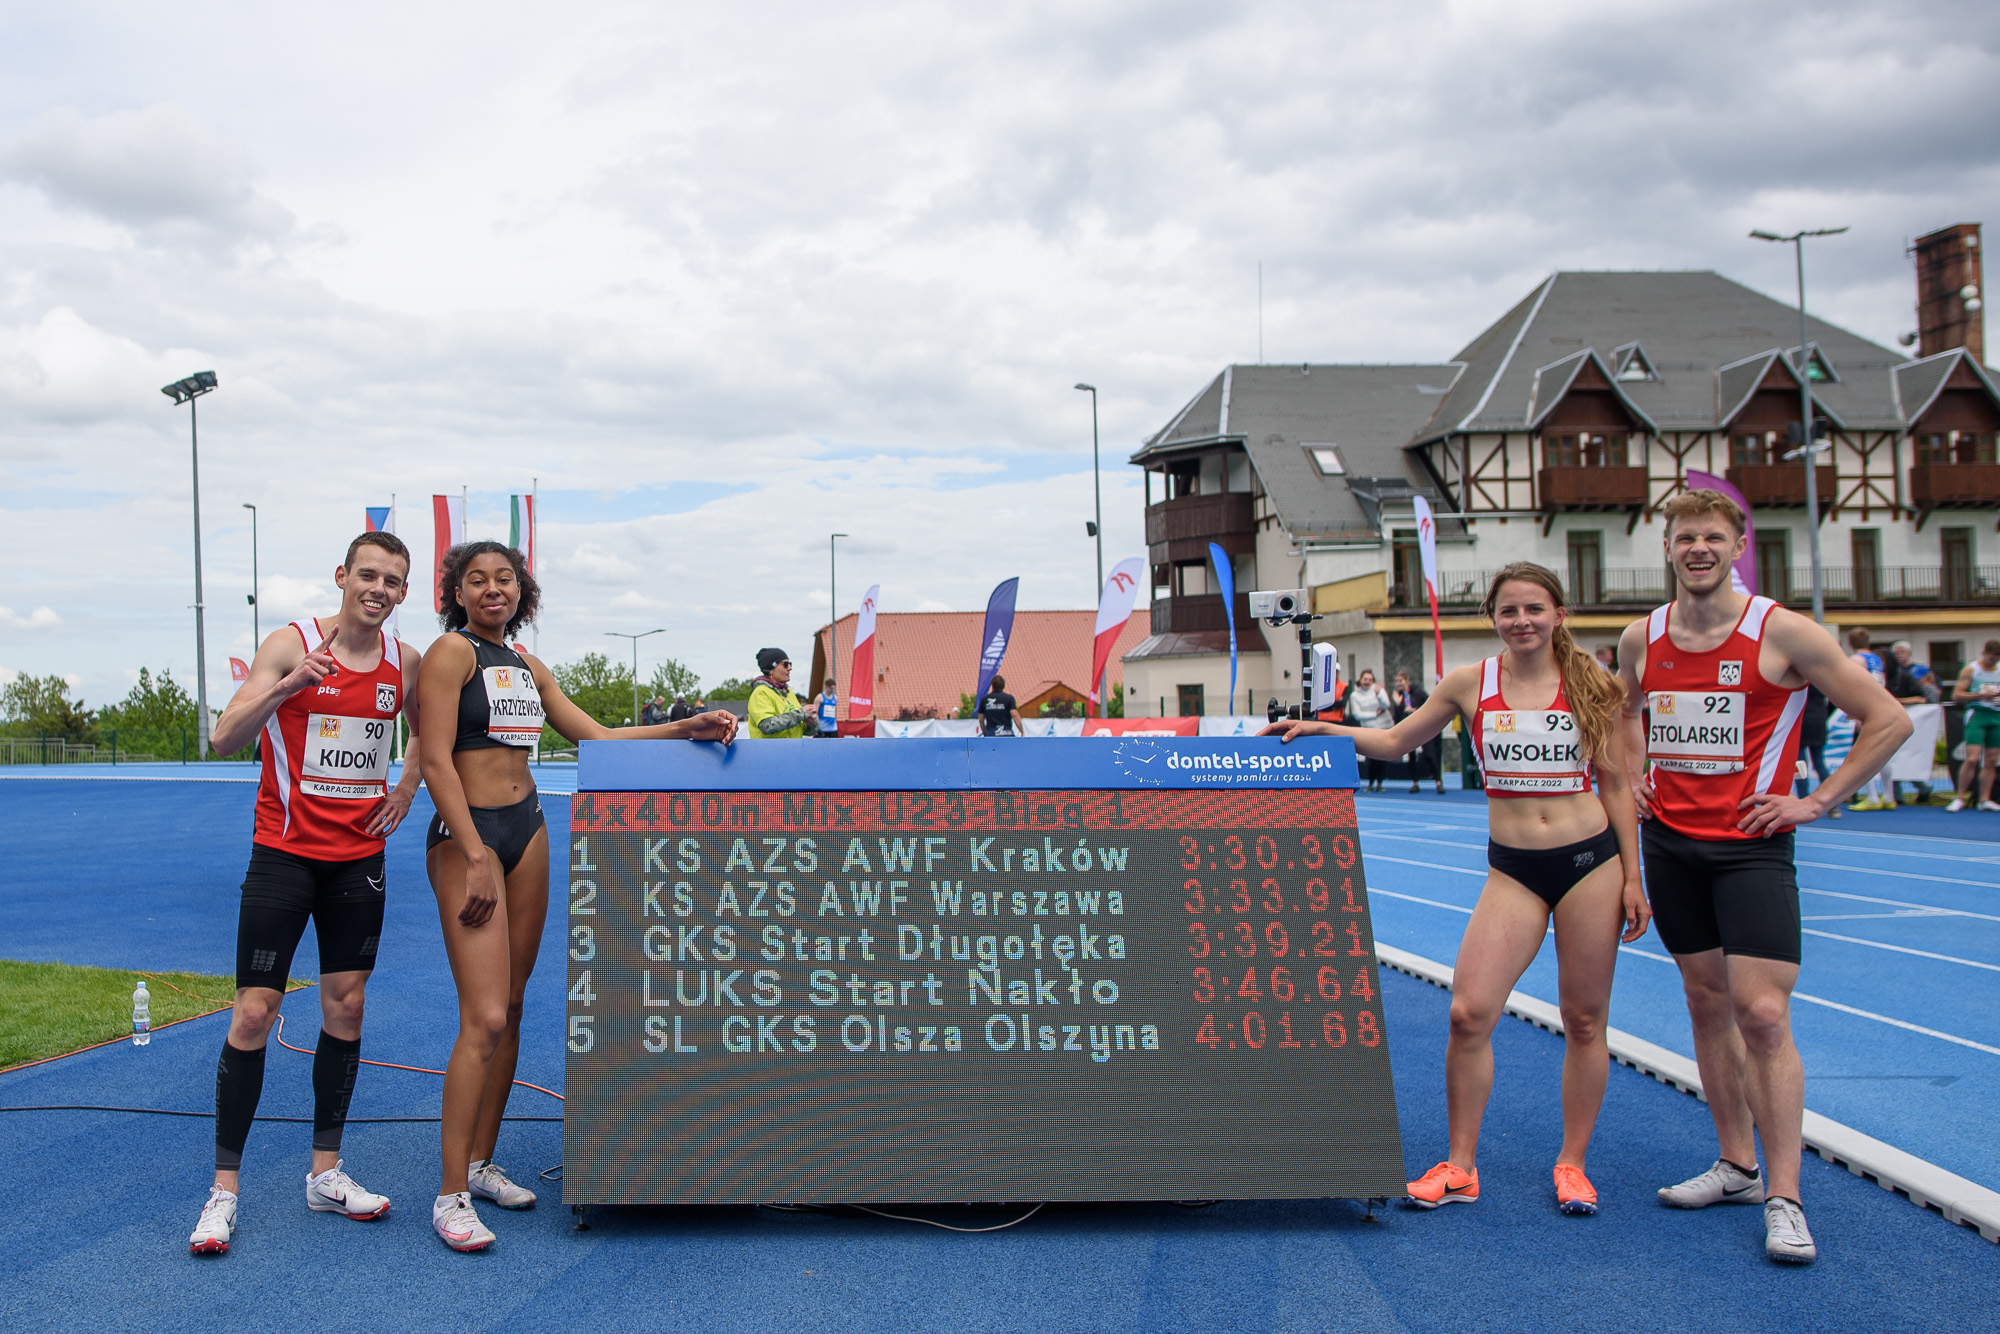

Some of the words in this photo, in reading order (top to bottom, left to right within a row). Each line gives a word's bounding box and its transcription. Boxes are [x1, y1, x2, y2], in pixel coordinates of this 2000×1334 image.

[522, 672, 534, 689] 91
[317, 686, 335, 695] pts
[1703, 696, 1731, 713] 92
[365, 722, 384, 740] 90
[1546, 714, 1574, 732] 93
[1652, 725, 1738, 745] STOLARSKI
[319, 748, 377, 769] KIDOŃ
[1166, 751, 1332, 773] domtel-sport.pl
[1488, 743, 1579, 762] WSOŁEK
[1696, 762, 1717, 770] 2022
[1191, 773, 1233, 783] systemy
[1498, 778, 1538, 787] KARPACZ
[313, 783, 351, 793] KARPACZ
[352, 786, 367, 794] 2022
[574, 794, 759, 827] 4x400m
[784, 794, 855, 826] Mix
[571, 837, 597, 872] 1
[644, 838, 700, 873] KS
[725, 838, 817, 873] AZS
[842, 837, 947, 873] AWF
[970, 837, 1129, 873] Kraków
[1179, 834, 1356, 870] 3:30.39
[570, 880, 597, 915] 2
[643, 881, 694, 917] KS
[716, 881, 796, 917] AZS
[818, 881, 909, 916] AWF
[931, 880, 1124, 916] Warszawa
[1184, 878, 1363, 913] 3:33.91
[569, 925, 596, 961] 3
[643, 925, 737, 962] GKS
[760, 925, 875, 961] Start
[898, 924, 1126, 970] Długołęka
[1188, 921, 1369, 958] 3:39.21
[568, 970, 597, 1006] 4
[643, 970, 783, 1007] LUKS
[809, 969, 944, 1006] Start
[969, 968, 1120, 1005] Nakło
[1193, 965, 1375, 1002] 3:46.64
[567, 1016, 595, 1053] 5
[643, 1015, 698, 1053] SL
[722, 1015, 817, 1053] GKS
[841, 1014, 962, 1052] Olsza
[985, 1013, 1159, 1062] Olszyna
[1195, 1011, 1381, 1049] 4:01.68
